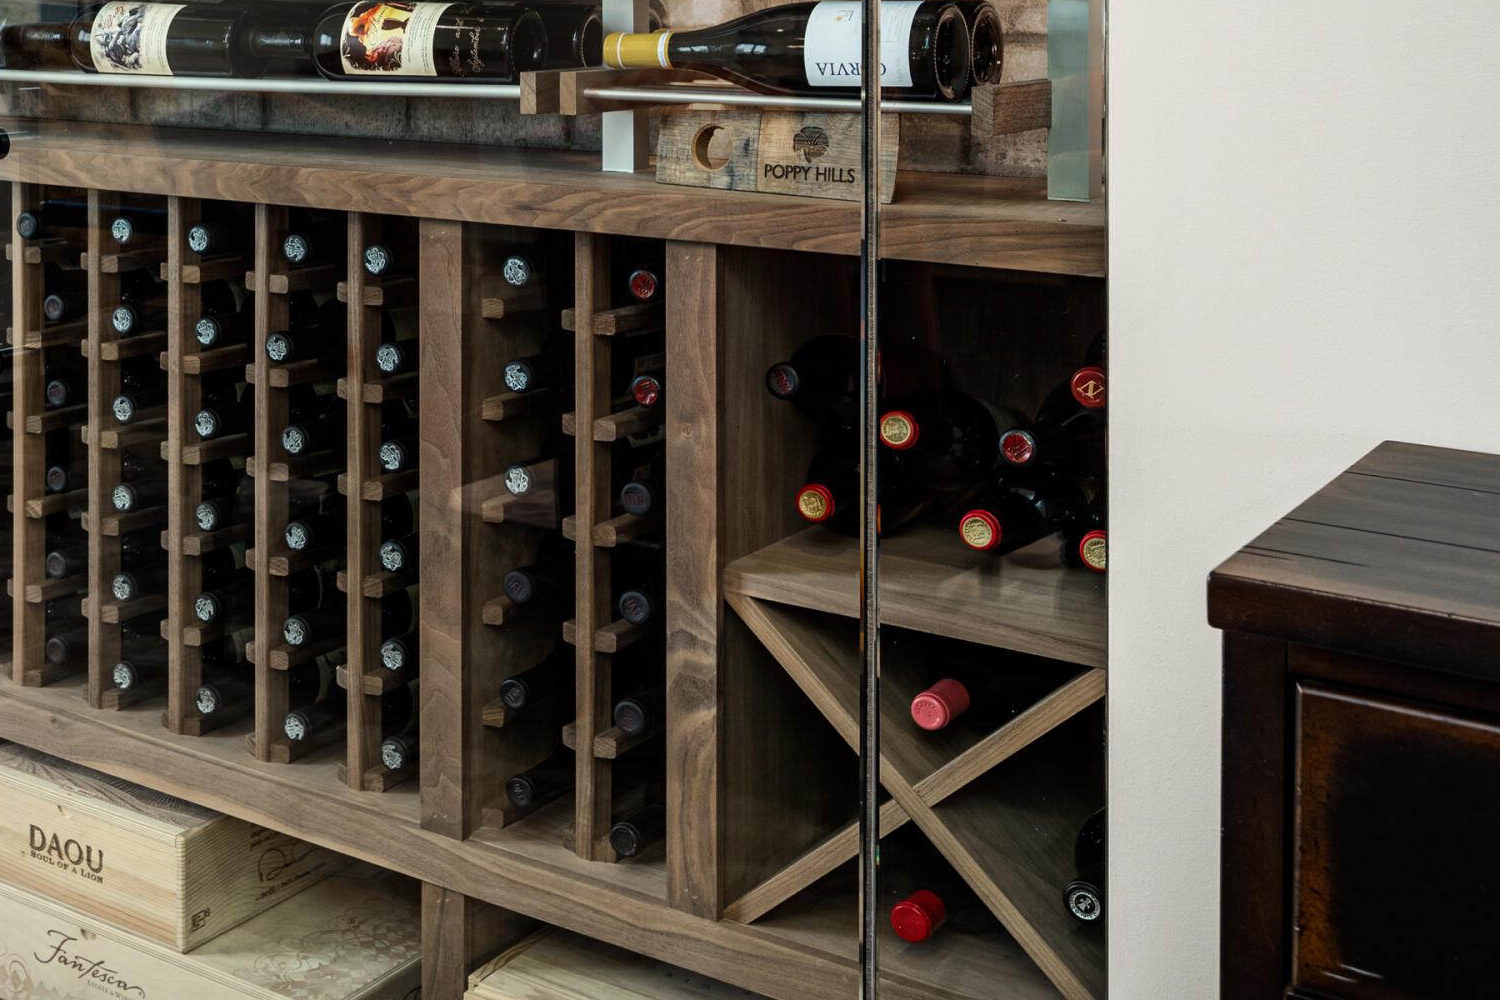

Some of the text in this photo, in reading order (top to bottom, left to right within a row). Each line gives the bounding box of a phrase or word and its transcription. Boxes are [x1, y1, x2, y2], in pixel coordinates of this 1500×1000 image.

[764, 163, 855, 183] POPPY HILLS
[29, 823, 104, 873] DAOU
[71, 866, 78, 875] A
[34, 929, 146, 999] Fantesca
